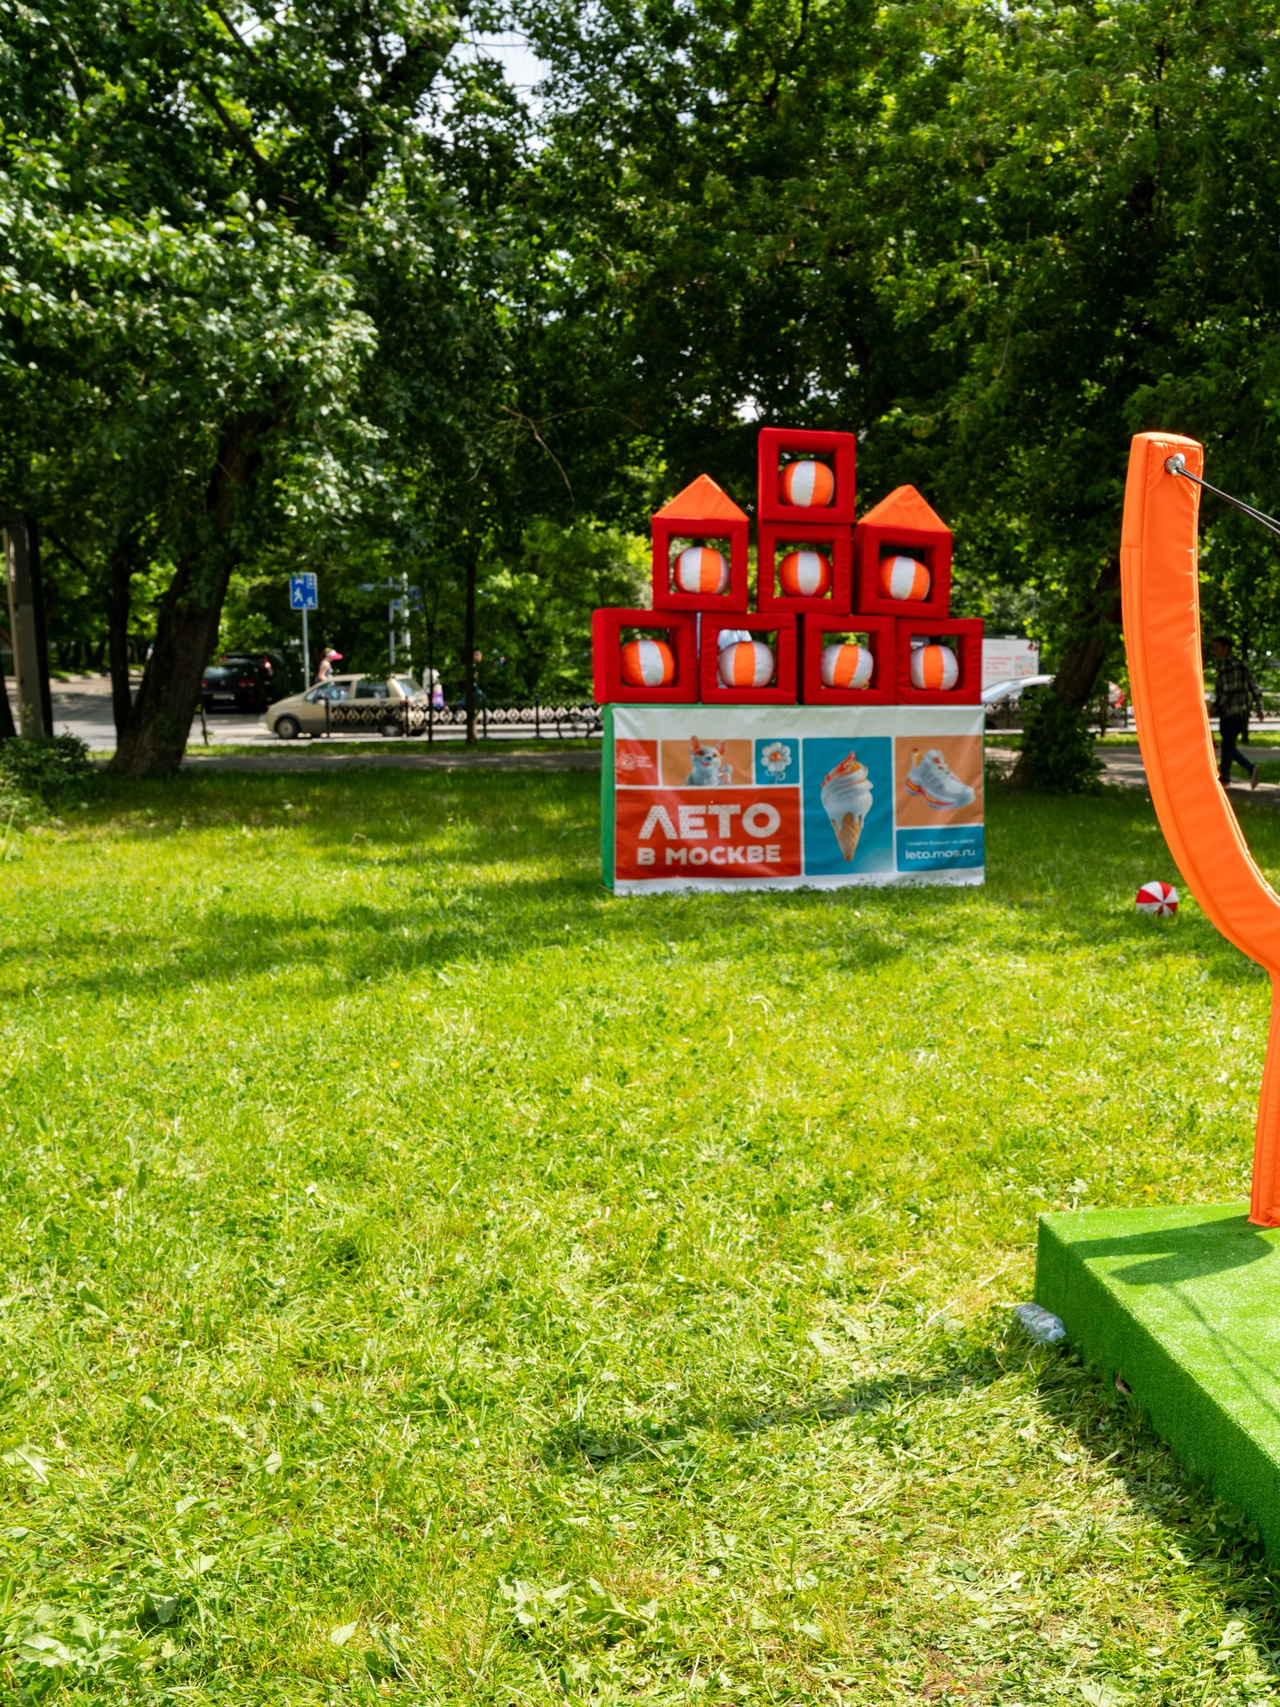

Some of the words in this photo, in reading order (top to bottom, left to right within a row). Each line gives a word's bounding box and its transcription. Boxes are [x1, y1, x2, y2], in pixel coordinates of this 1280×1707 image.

[638, 802, 781, 840] ЛЕТО
[636, 847, 656, 866] В
[664, 844, 781, 866] МОСКВЕ
[905, 848, 976, 860] leto.mos.ru
